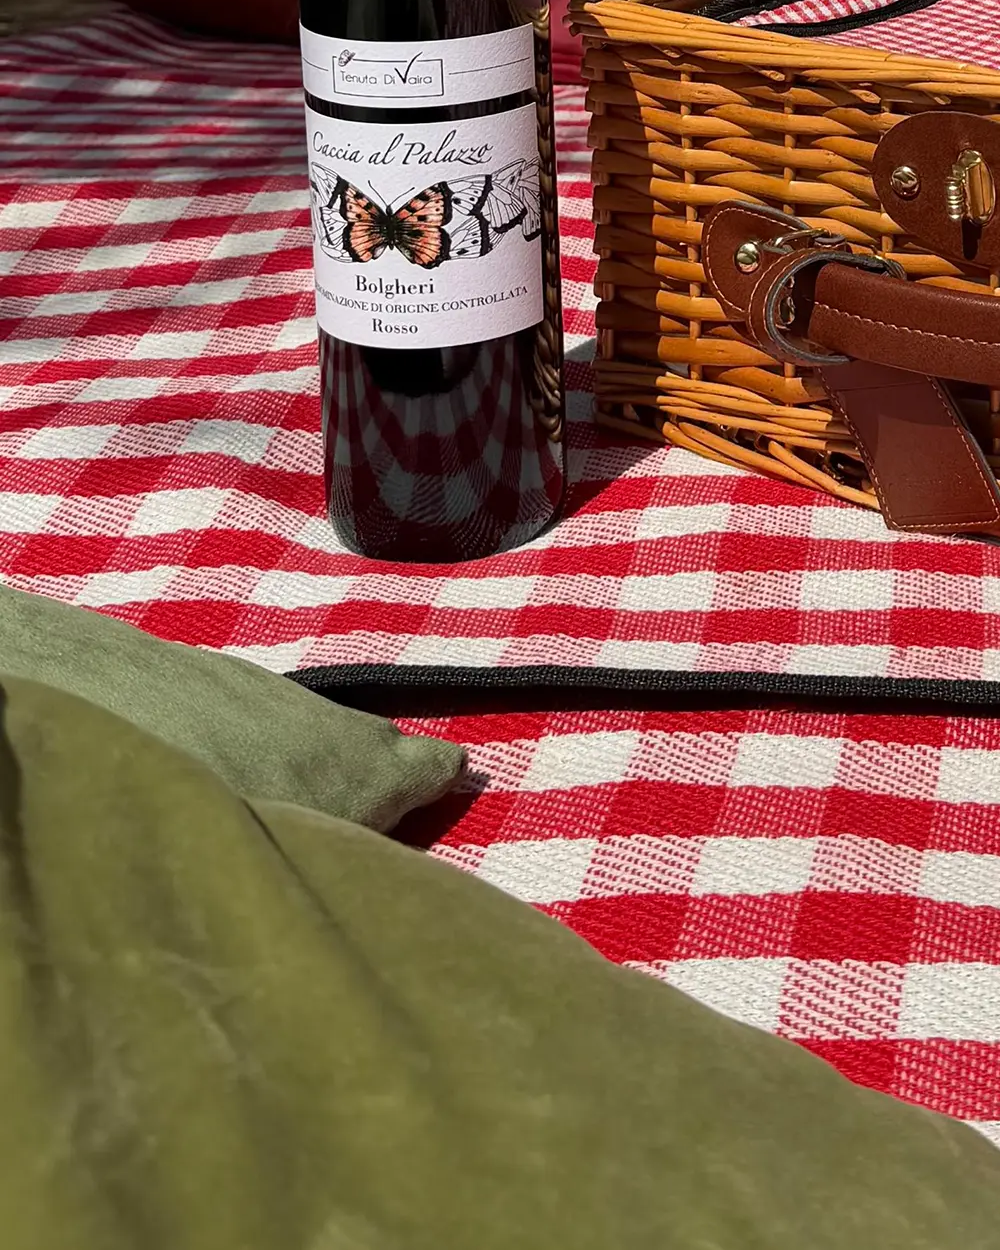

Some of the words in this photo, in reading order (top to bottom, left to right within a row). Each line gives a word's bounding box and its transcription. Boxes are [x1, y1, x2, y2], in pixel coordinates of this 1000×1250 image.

[340, 70, 378, 85] Tenuta
[312, 131, 364, 164] Caccia
[368, 133, 404, 165] al
[402, 129, 493, 165] Palazzo
[355, 274, 435, 299] Bolgheri
[371, 302, 383, 313] DI
[385, 303, 440, 313] ORIGINE
[441, 284, 529, 312] CONTROLLATA
[371, 318, 419, 334] Rosso
